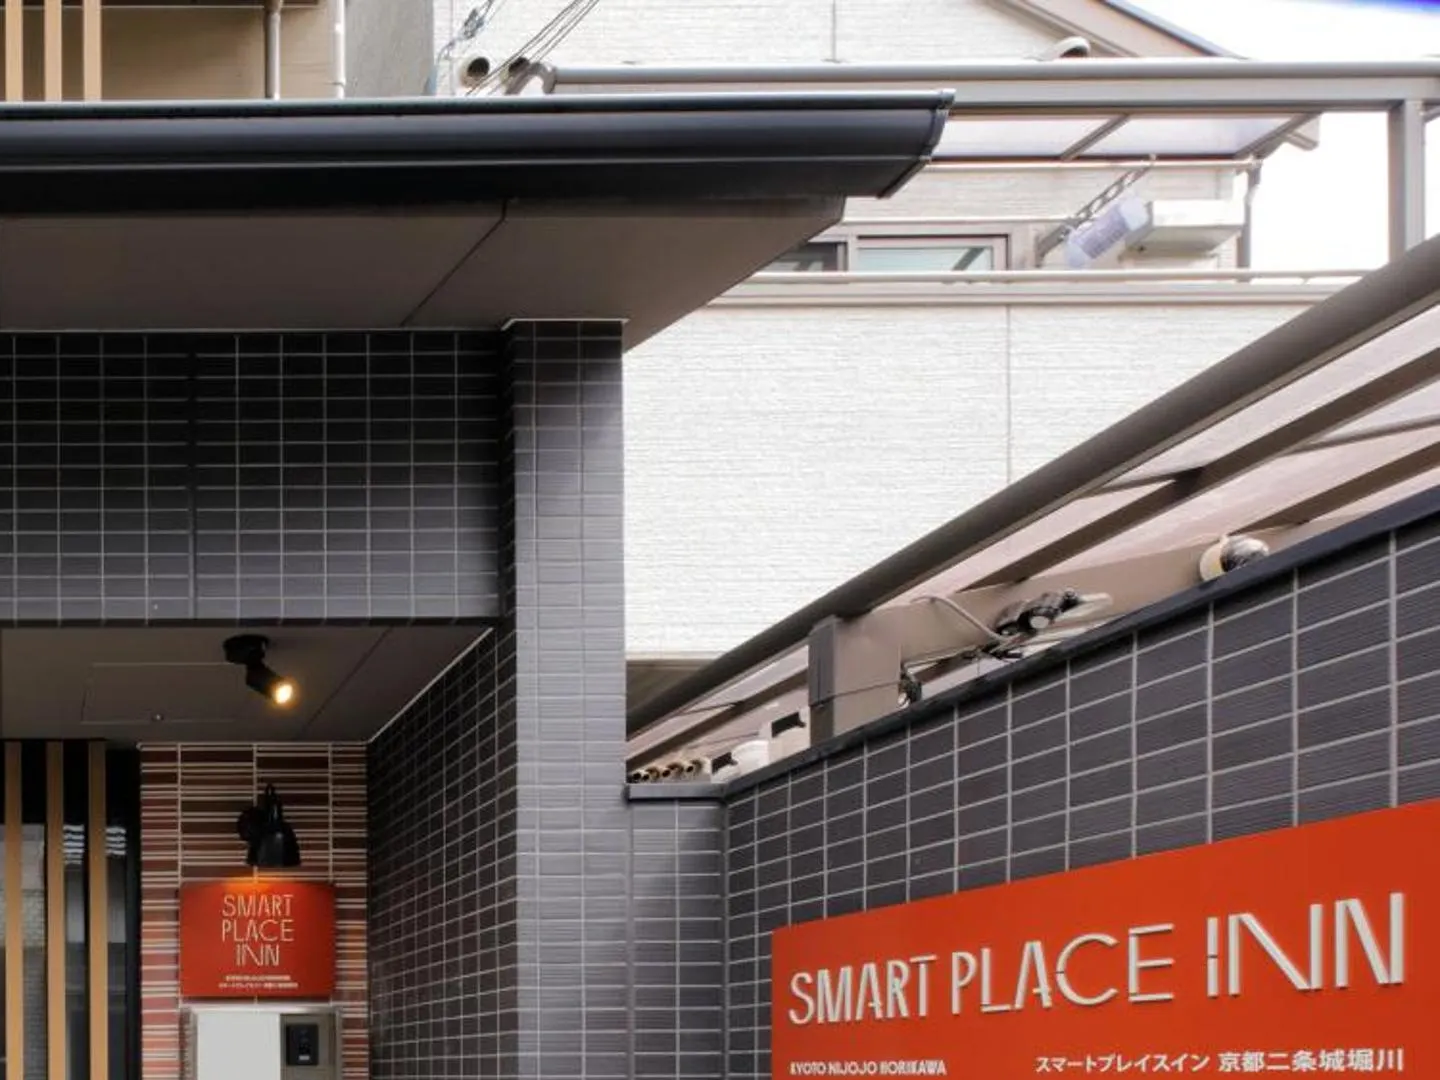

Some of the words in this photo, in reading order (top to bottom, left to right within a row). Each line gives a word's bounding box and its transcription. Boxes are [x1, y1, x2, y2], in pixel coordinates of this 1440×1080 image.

[222, 894, 294, 916] SMART
[222, 919, 294, 942] PLACE
[236, 944, 280, 966] INN
[788, 954, 936, 1025] SMART
[950, 922, 1175, 1015] PLACE
[1205, 891, 1405, 999] INN
[1218, 1048, 1404, 1072] 京都二条城堀川
